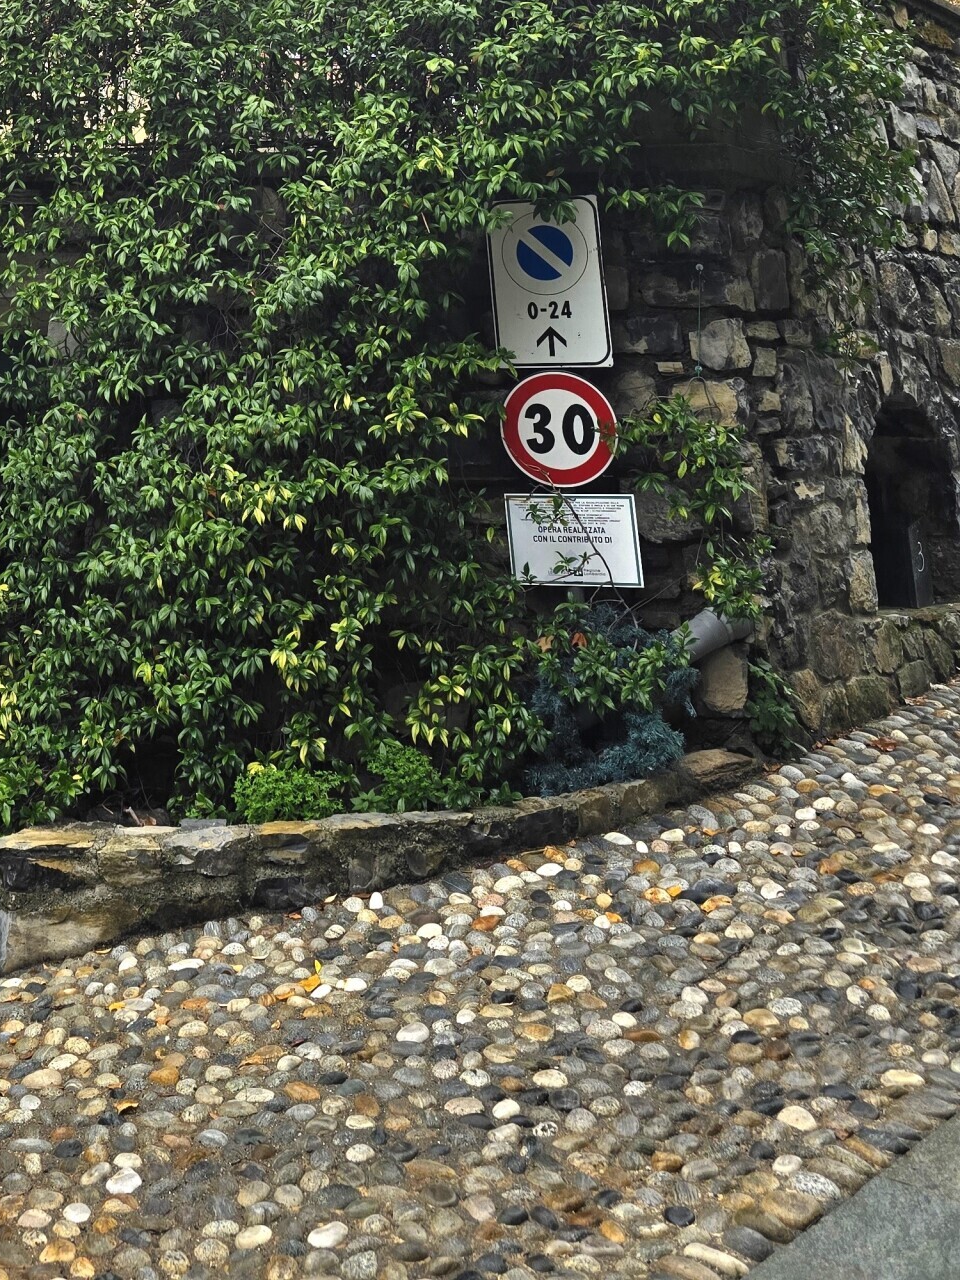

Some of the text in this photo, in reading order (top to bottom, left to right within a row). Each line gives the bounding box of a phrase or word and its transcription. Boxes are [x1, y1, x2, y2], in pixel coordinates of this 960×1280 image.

[527, 301, 572, 319] 0-24
[524, 403, 595, 455] 30
[533, 535, 548, 543] CON
[549, 535, 556, 543] IL
